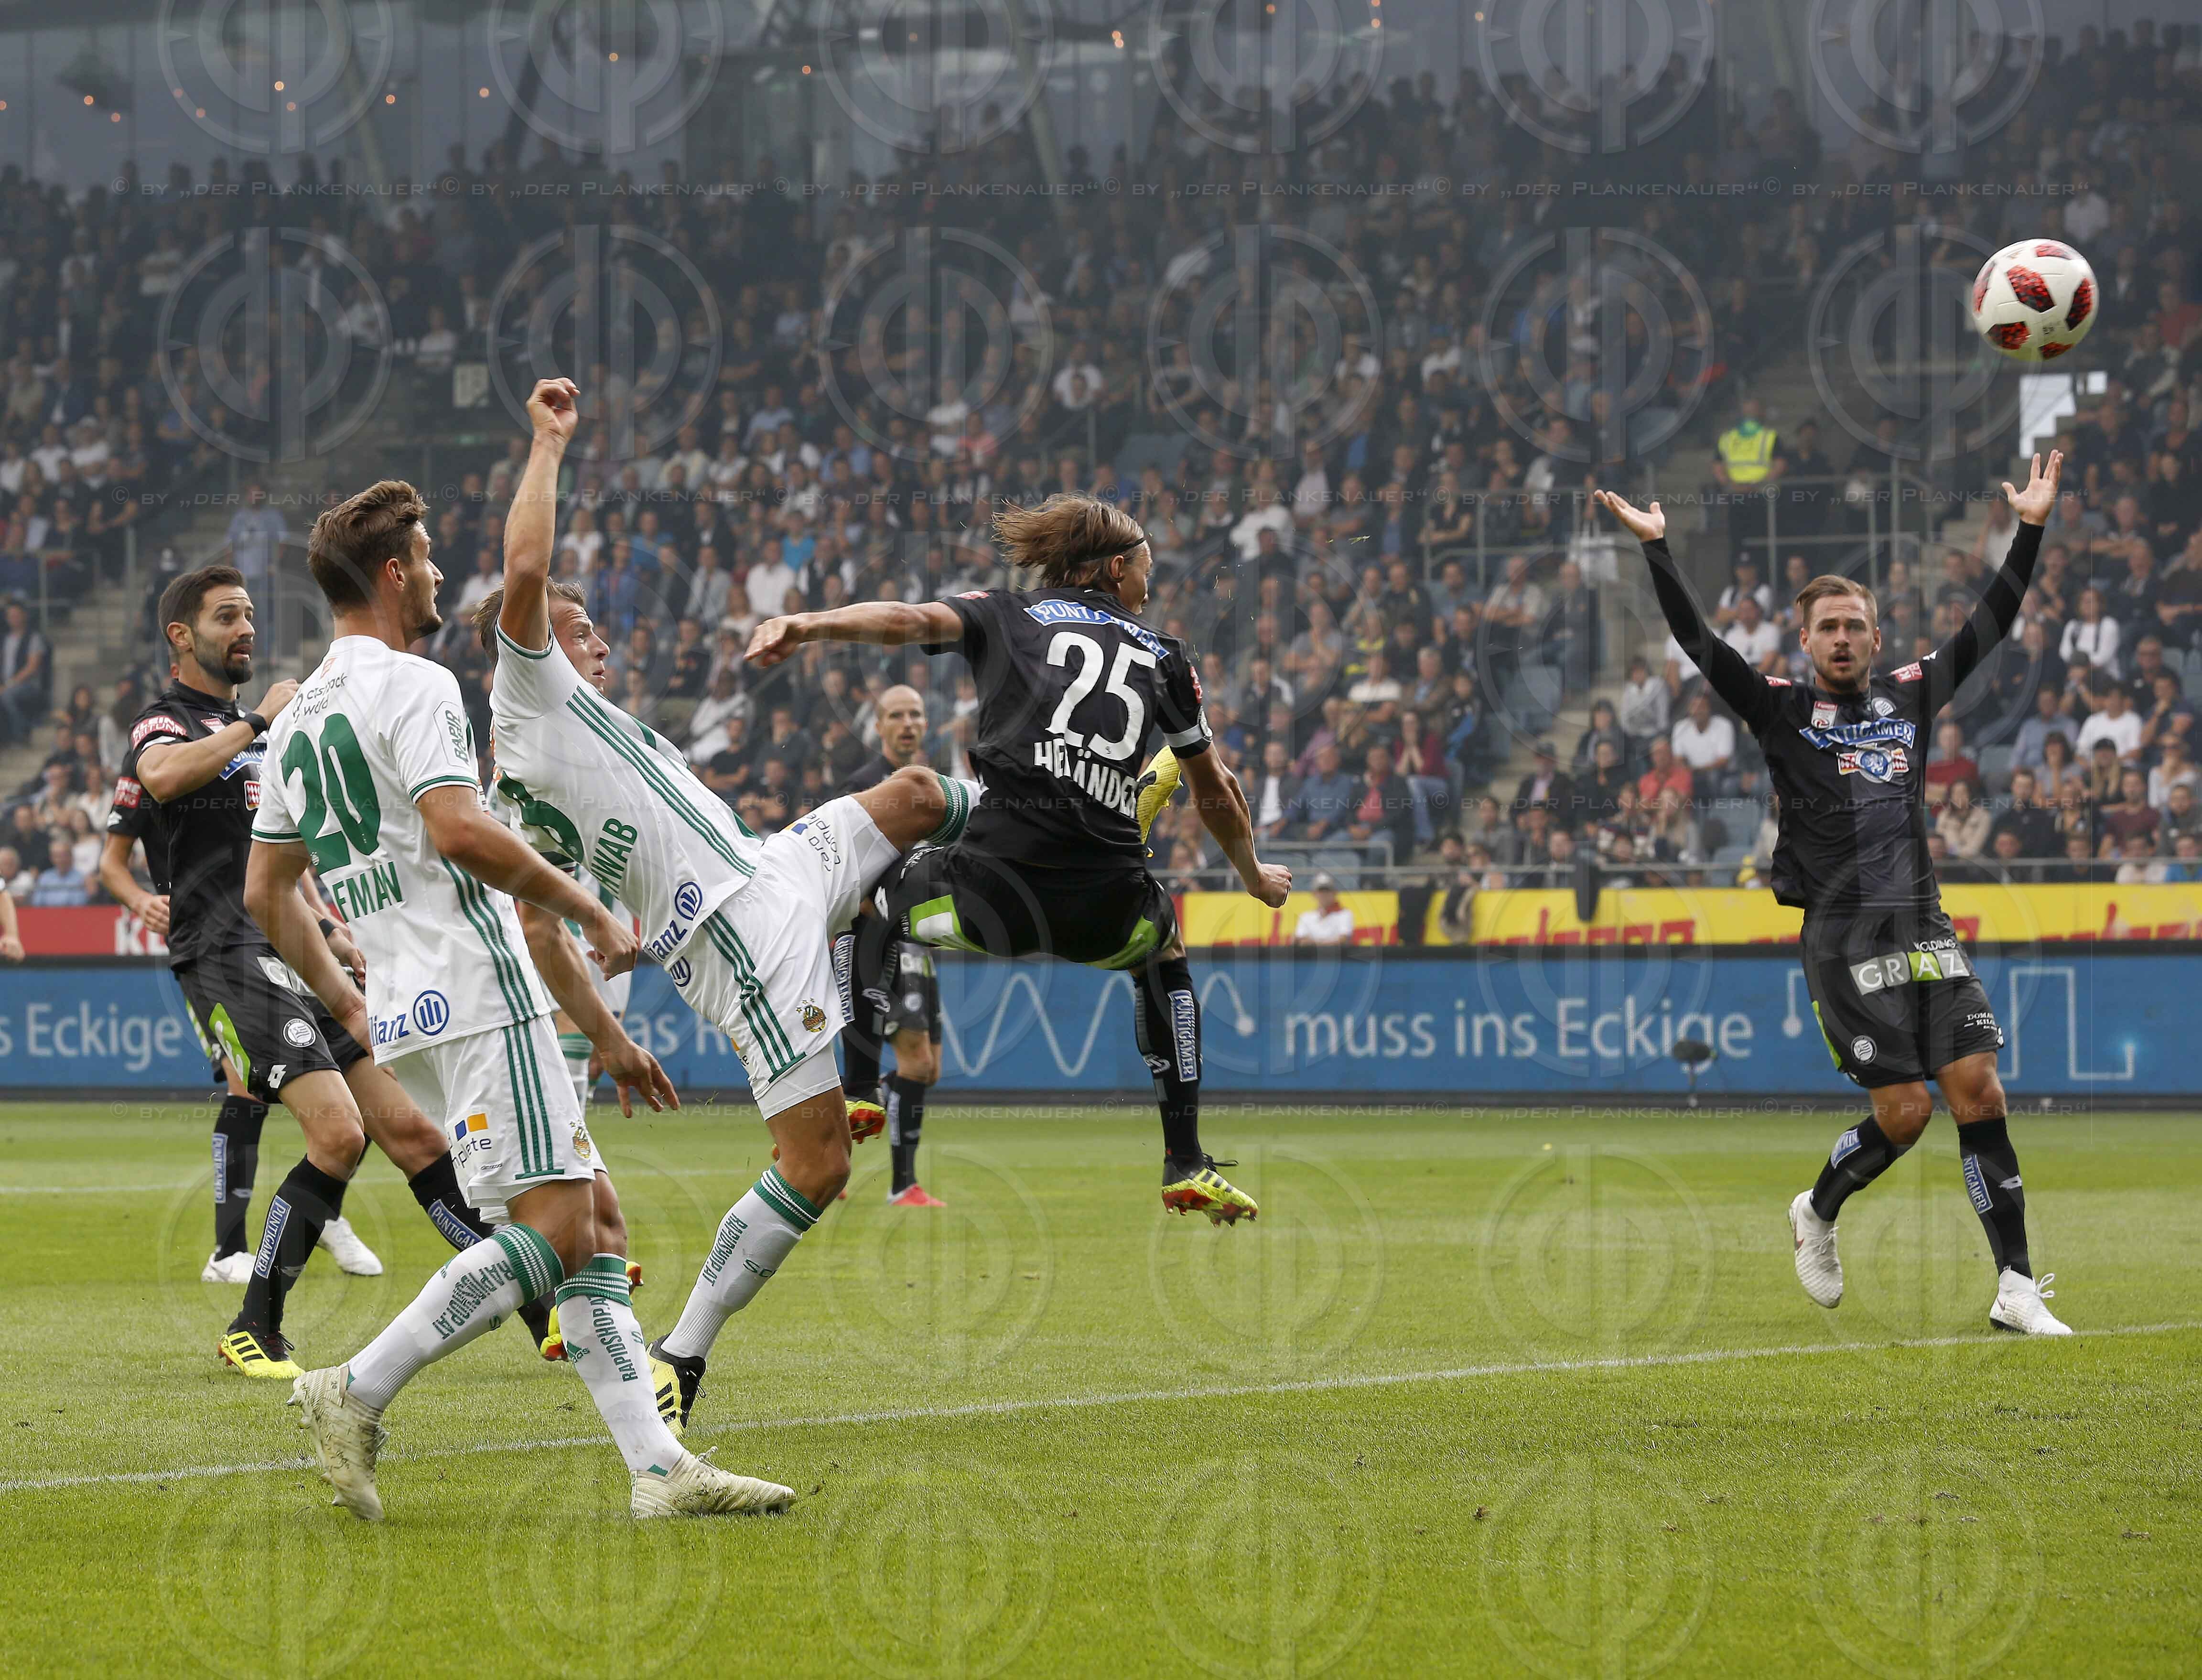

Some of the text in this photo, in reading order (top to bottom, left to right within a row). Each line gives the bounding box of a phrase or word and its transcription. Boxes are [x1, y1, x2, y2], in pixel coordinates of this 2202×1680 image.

[1045, 632, 1157, 761] 25
[281, 713, 381, 875] 20
[1858, 953, 1964, 988] GRAZ
[26, 1001, 184, 1072] Eckige
[1285, 1011, 1436, 1058] muss
[1454, 998, 1538, 1058] ins
[257, 1201, 286, 1273] PUNTIGAMER
[588, 1296, 638, 1382] RAPIDSHOP.A
